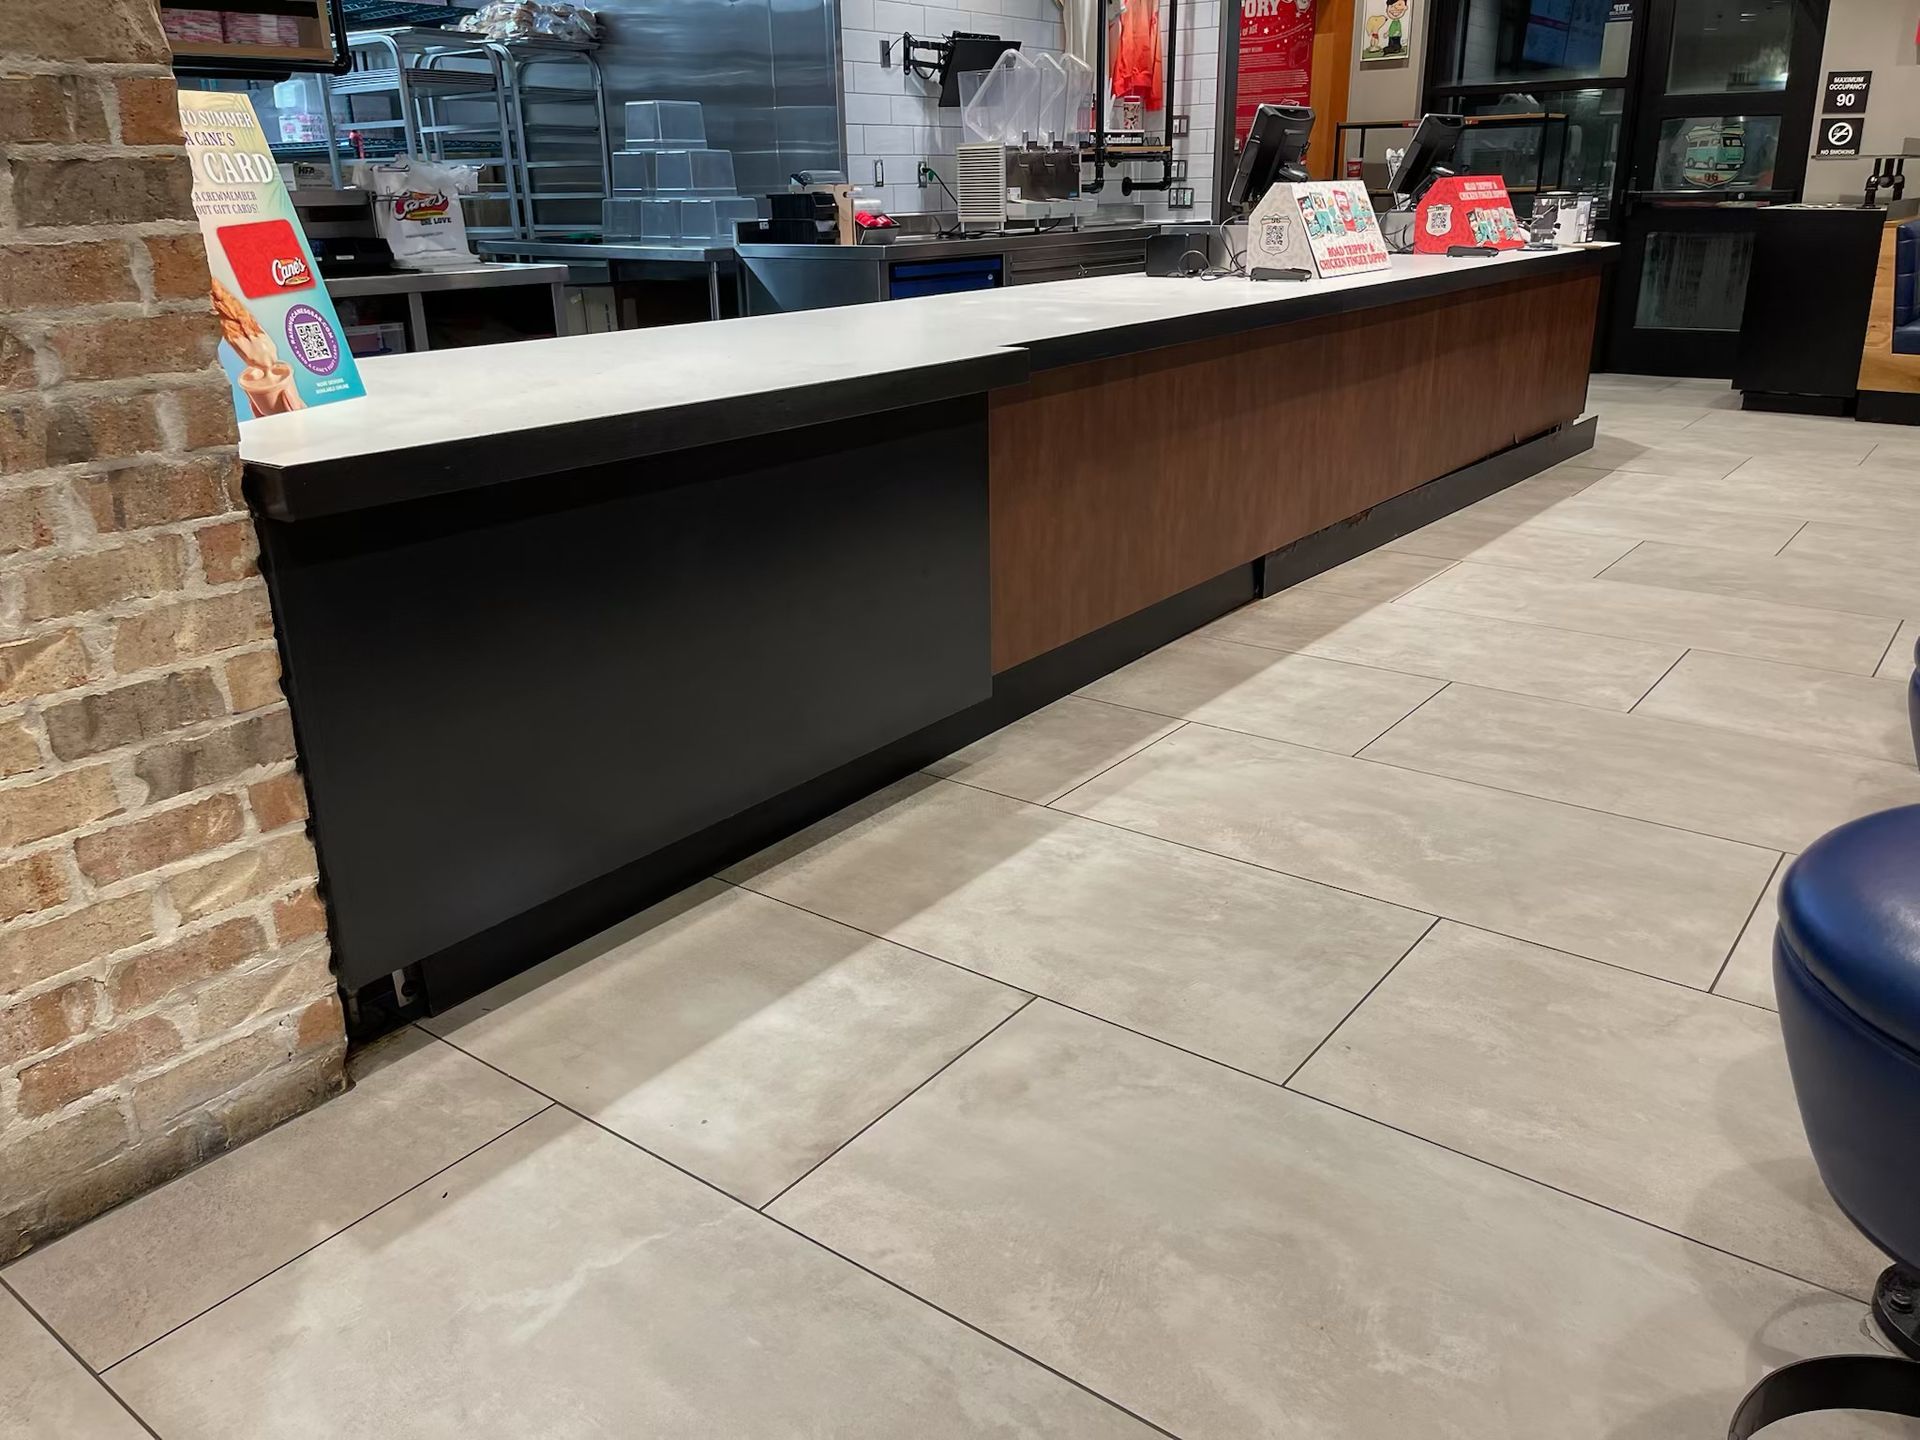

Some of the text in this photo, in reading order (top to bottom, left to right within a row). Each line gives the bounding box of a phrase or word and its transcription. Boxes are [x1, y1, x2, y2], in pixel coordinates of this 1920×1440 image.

[1828, 83, 1867, 91] OCCUPANCY
[1836, 93, 1855, 106] 90
[199, 110, 255, 128] SUMMER
[184, 131, 235, 147] A CANE'S
[203, 152, 274, 184] CARD
[194, 191, 258, 202] A CREWMEMBER
[213, 203, 232, 215] GIFT
[232, 203, 258, 214] CARDS!
[433, 216, 452, 225] LOVE
[1327, 245, 1345, 257] ROAD
[1369, 242, 1375, 252] &
[1319, 257, 1347, 270] CHICKEN
[1346, 254, 1368, 267] FINGER
[271, 257, 306, 286] Cane's
